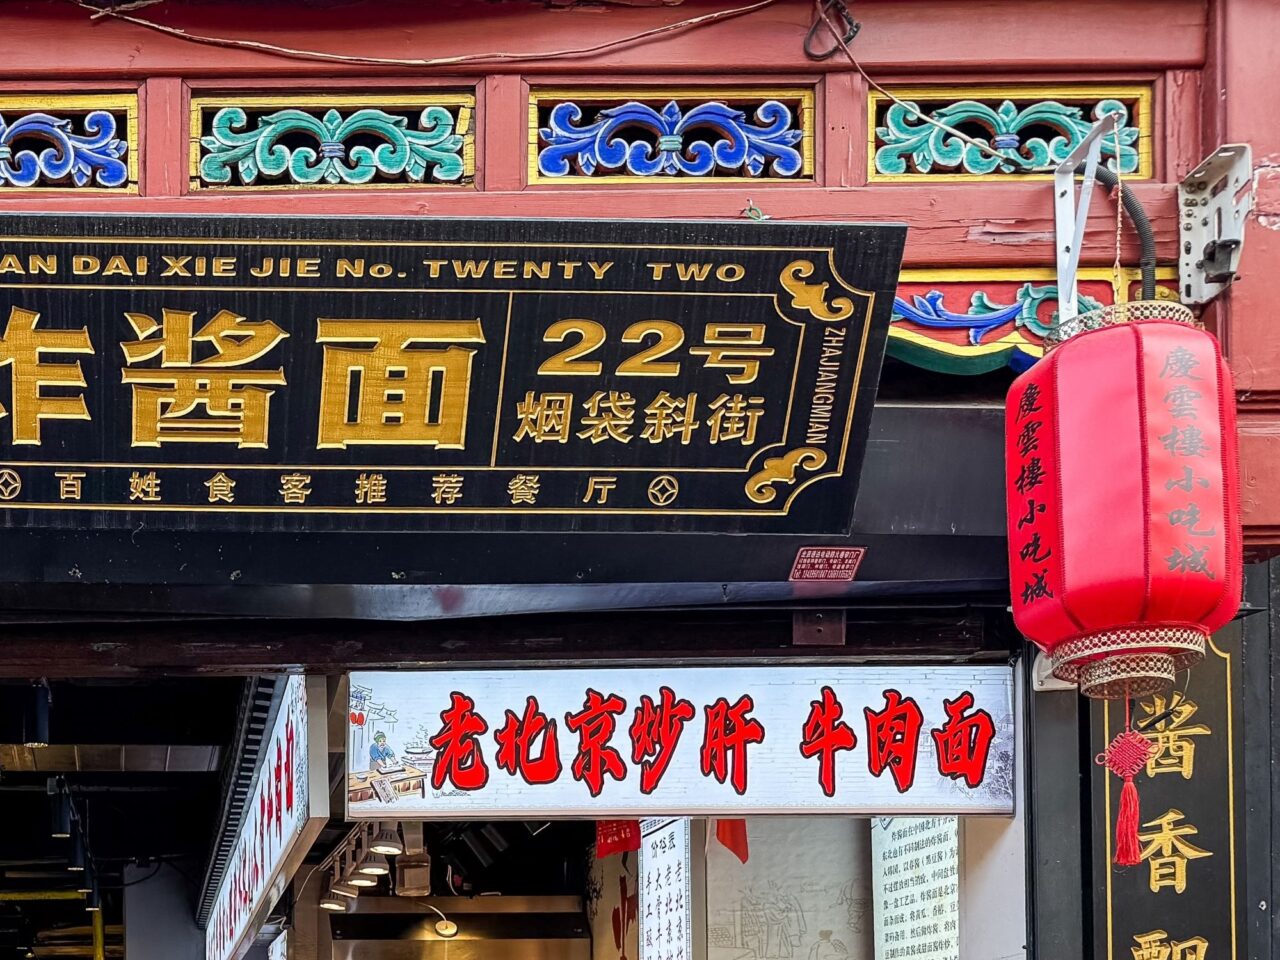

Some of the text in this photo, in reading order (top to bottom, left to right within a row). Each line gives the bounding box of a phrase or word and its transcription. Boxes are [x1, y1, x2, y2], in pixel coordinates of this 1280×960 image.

[72, 254, 148, 276] DAI
[160, 255, 237, 278] XIE
[250, 256, 321, 278] JIE
[422, 259, 615, 280] TWENTY
[646, 261, 746, 282] TWO
[536, 317, 776, 385] 22号
[805, 325, 847, 445] ZHAJIANGMIAN
[512, 390, 766, 446] 烟袋斜街
[1156, 344, 1217, 581] 慶雲樓小吃城
[54, 470, 618, 505] 百姓食客推荐餐厅
[1013, 381, 1055, 607] 慶雲樓小吃城
[429, 685, 996, 797] 老北京炒肝 牛肉面
